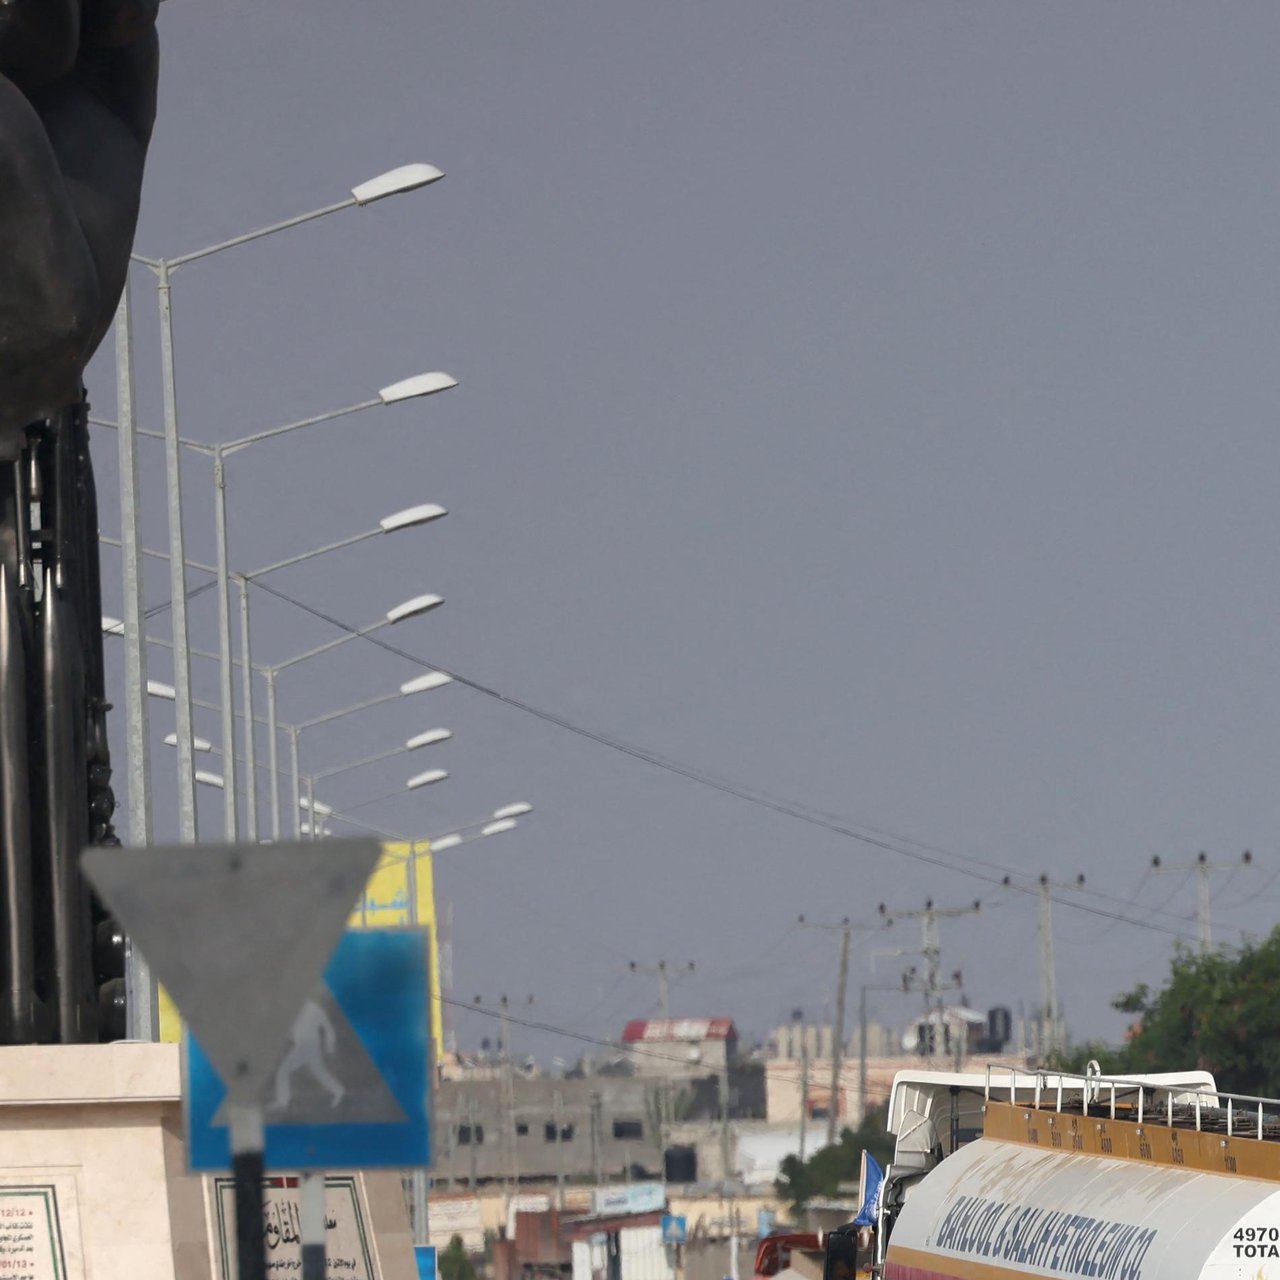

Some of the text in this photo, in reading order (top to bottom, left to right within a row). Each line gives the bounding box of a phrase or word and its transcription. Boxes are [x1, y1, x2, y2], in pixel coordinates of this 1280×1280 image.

[936, 1195, 1010, 1257] BAHLOOL
[992, 1205, 1021, 1258] &
[1004, 1207, 1064, 1269] SALAH
[1050, 1213, 1139, 1280] PETROLEUM
